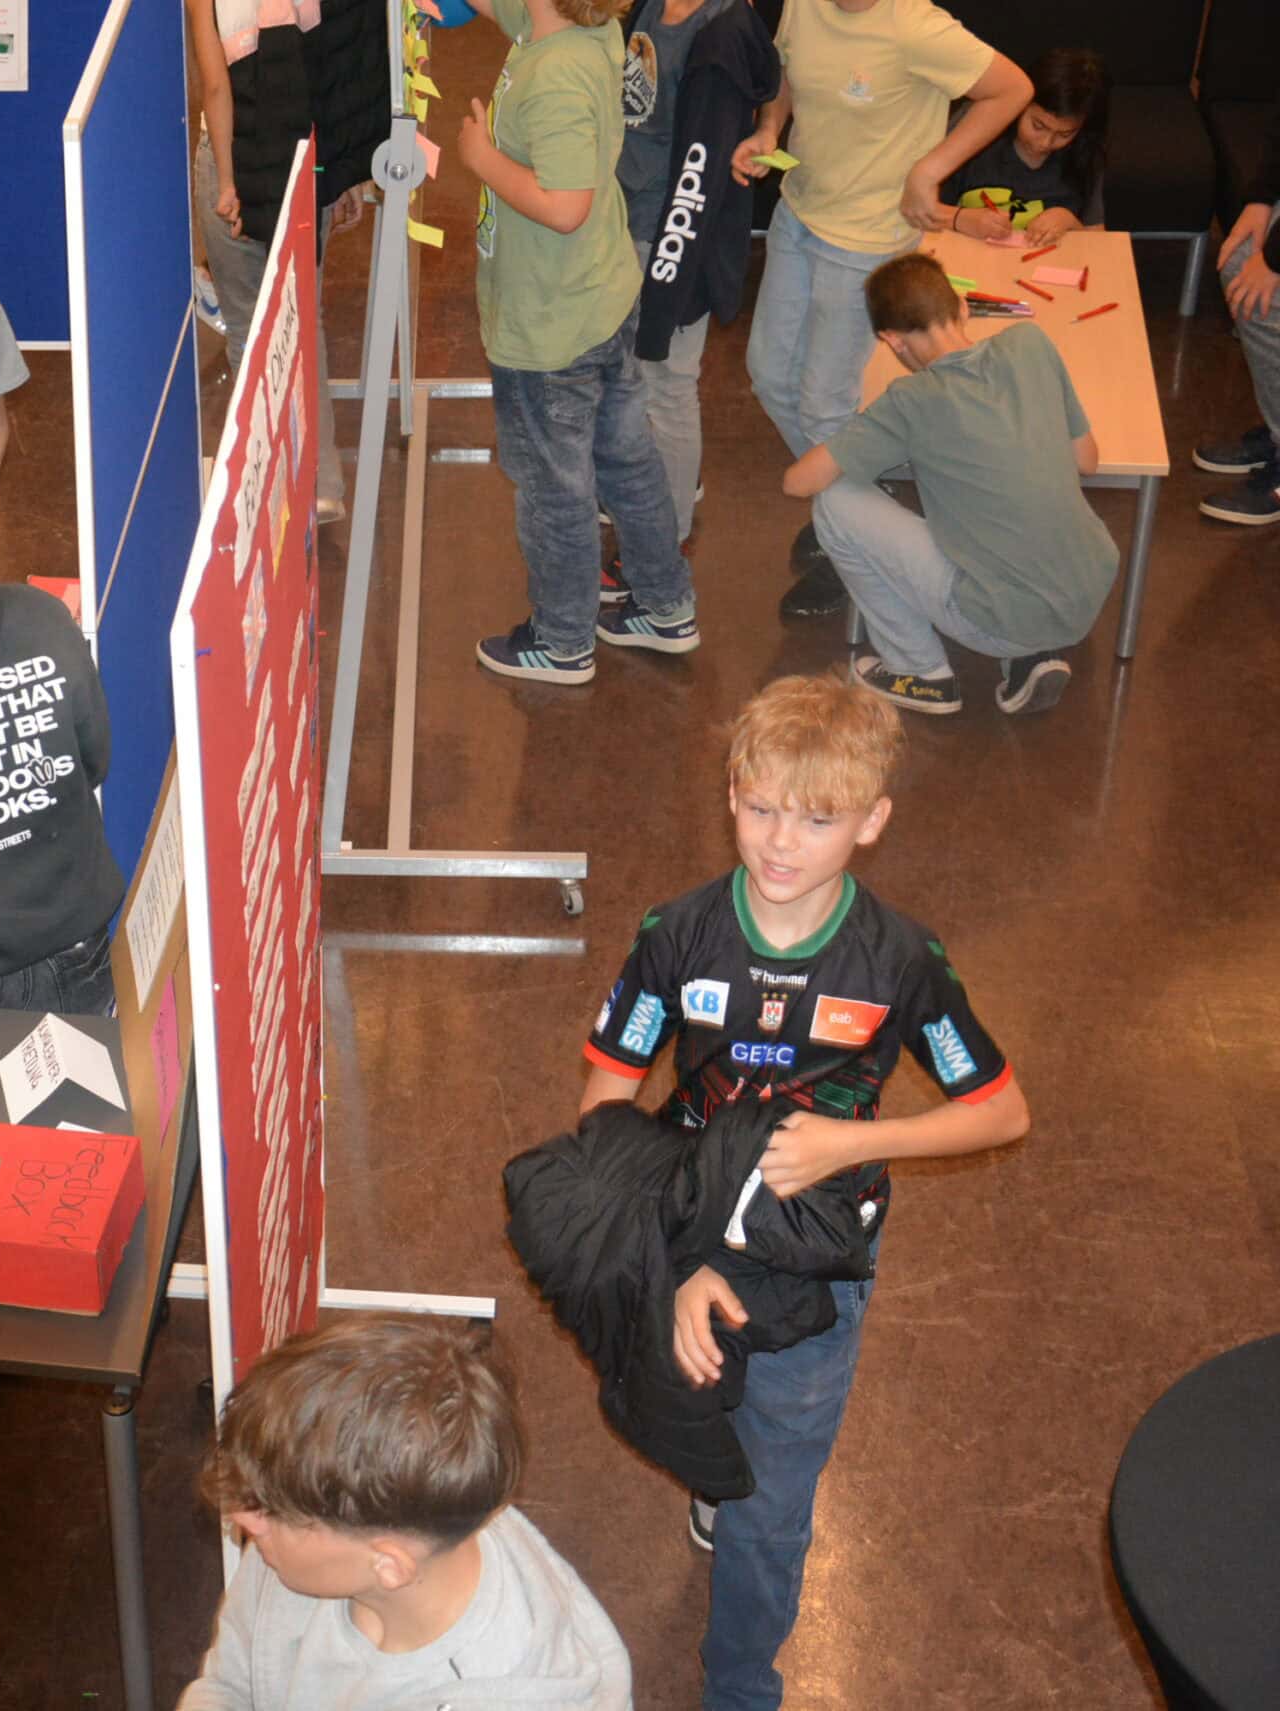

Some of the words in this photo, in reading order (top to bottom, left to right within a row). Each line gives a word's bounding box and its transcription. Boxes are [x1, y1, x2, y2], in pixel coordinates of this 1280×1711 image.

[651, 142, 707, 284] adidas
[15, 708, 58, 738] BE
[12, 739, 44, 765] IN
[762, 971, 808, 986] hummel
[932, 1018, 974, 1079] SWM
[39, 1137, 129, 1249] Feedback
